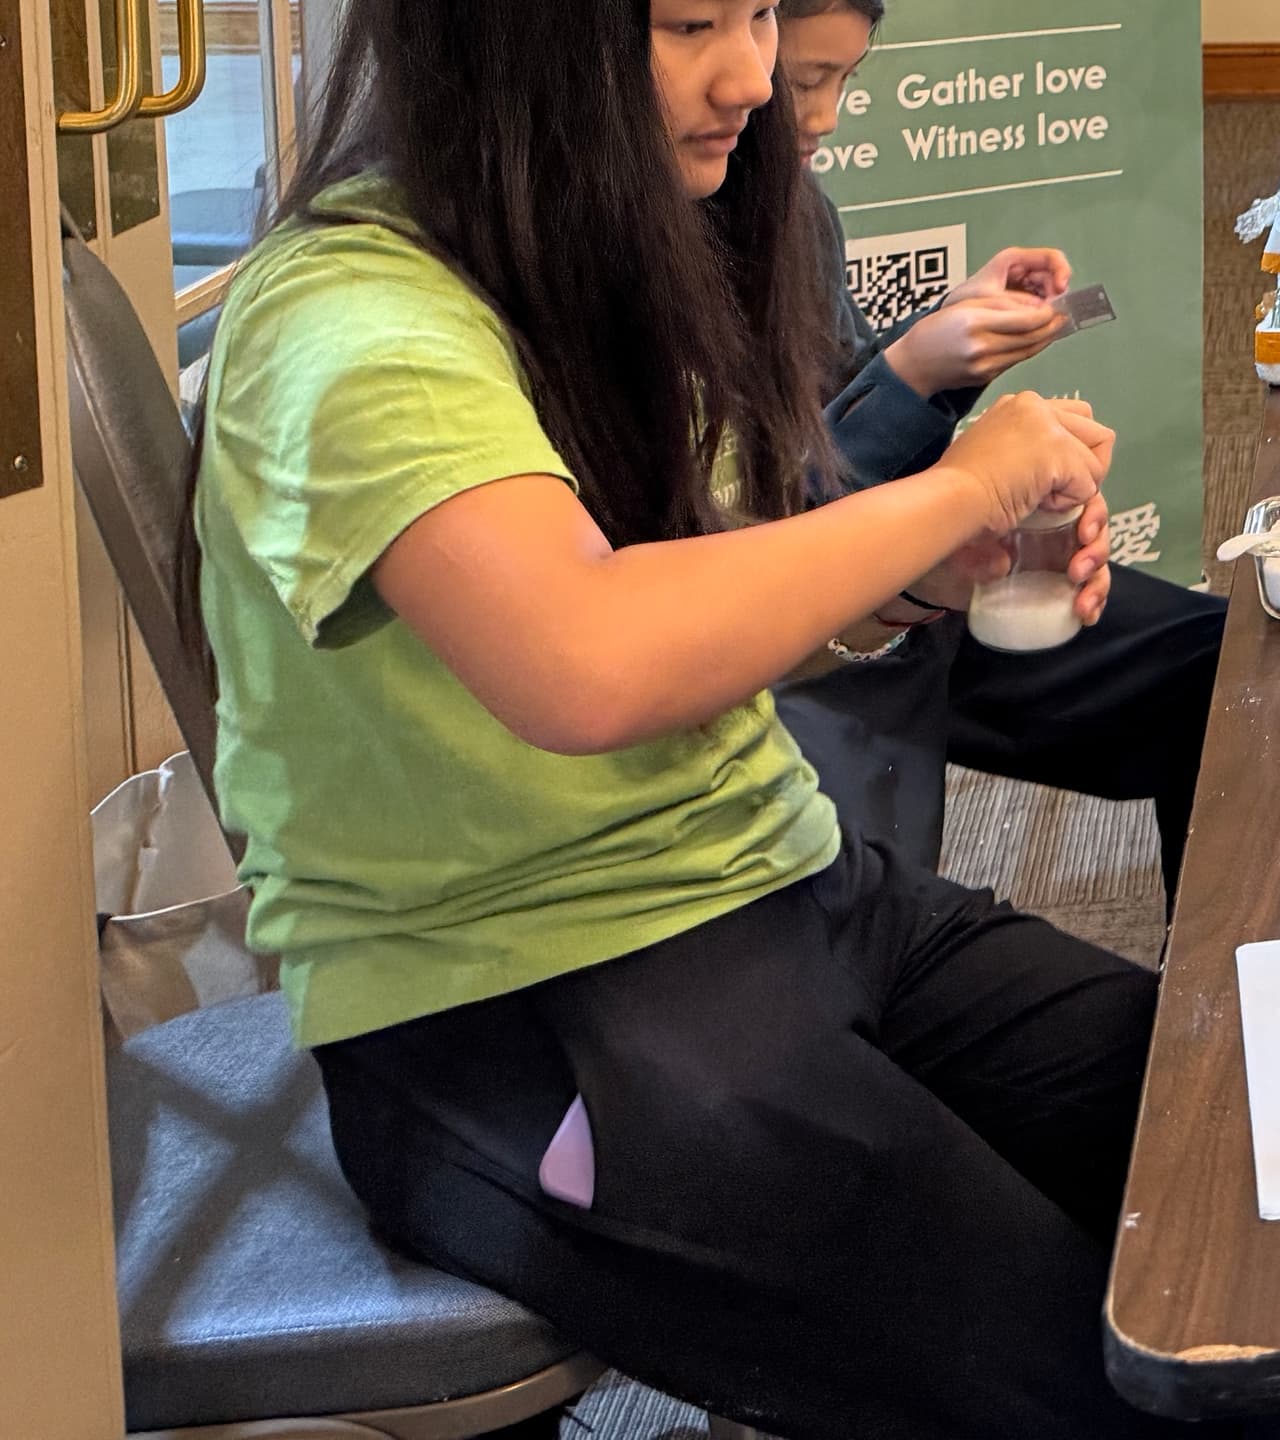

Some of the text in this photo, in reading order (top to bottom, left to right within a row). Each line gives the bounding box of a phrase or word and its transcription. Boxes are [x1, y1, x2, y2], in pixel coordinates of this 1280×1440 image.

[897, 69, 1024, 111] Gather
[1035, 61, 1107, 96] love
[811, 110, 1109, 174] ove Witness love
